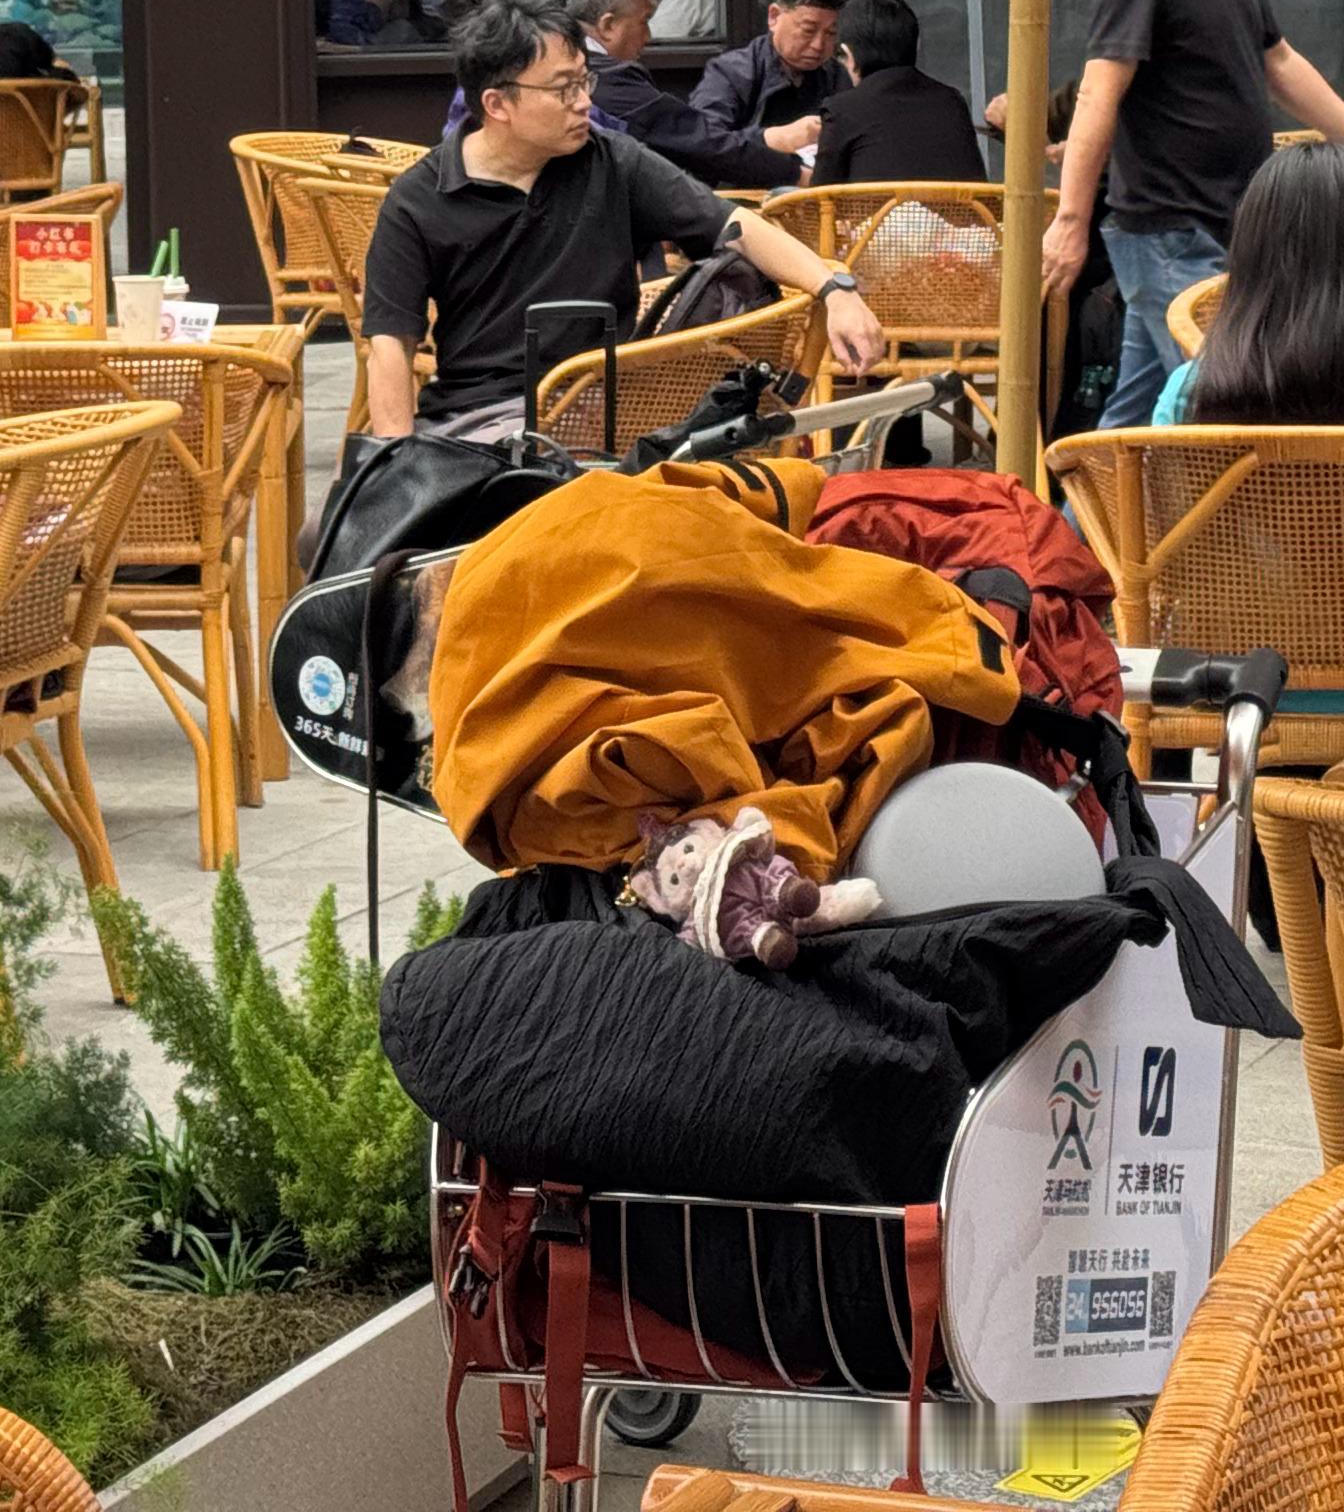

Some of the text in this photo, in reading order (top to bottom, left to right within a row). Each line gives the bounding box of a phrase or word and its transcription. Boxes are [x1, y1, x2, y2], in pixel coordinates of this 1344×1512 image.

[1117, 1162, 1185, 1195] 天津银行
[1116, 1199, 1182, 1216] BANK OF TIANJIN
